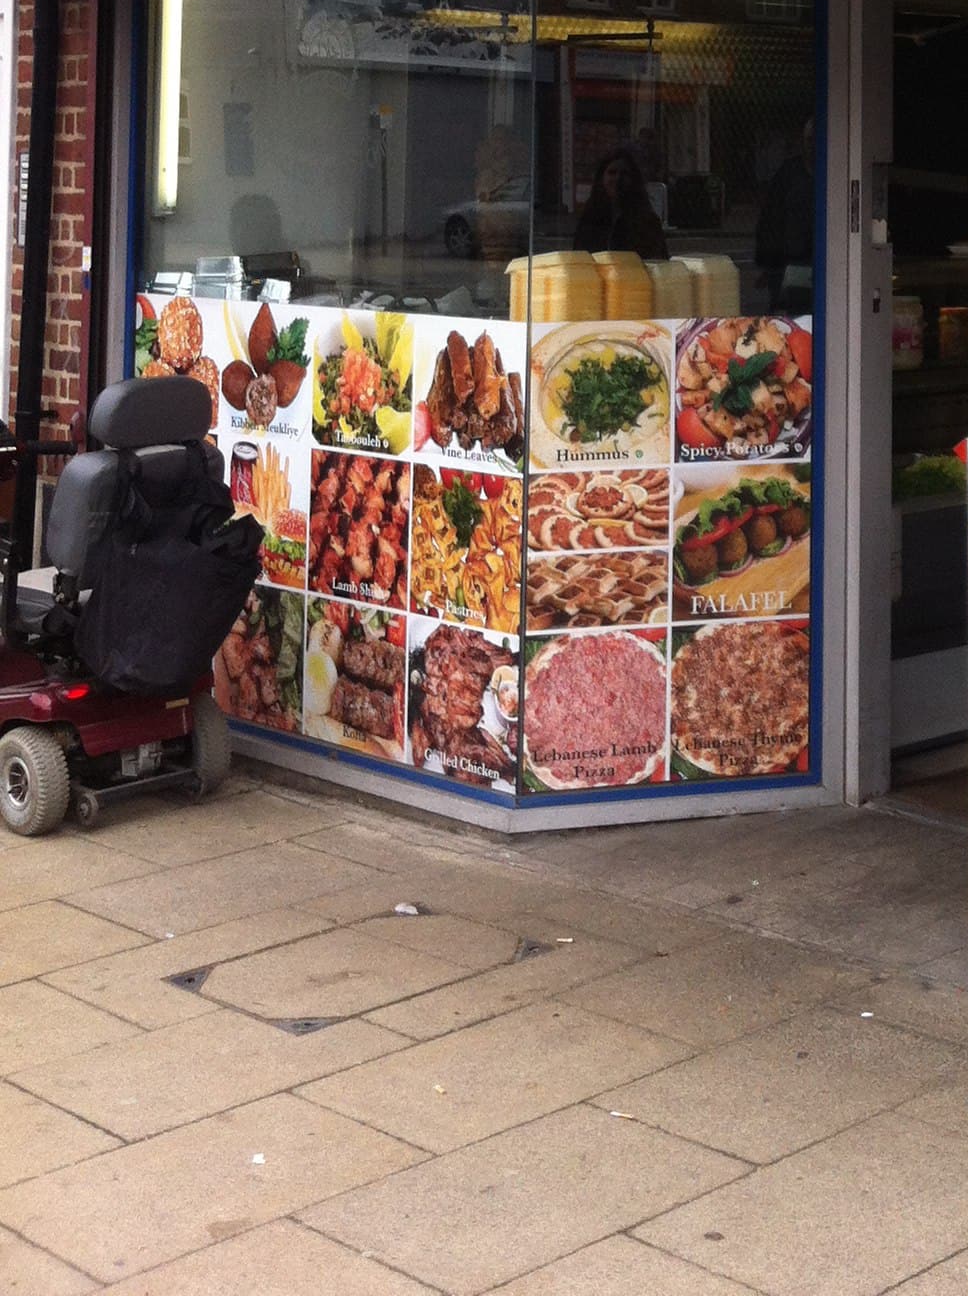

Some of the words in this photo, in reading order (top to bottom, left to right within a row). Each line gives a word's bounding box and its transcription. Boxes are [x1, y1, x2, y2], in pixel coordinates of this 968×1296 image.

[464, 449, 498, 463] Leaves
[556, 448, 630, 462] Hummus
[680, 442, 723, 460] Spicy
[332, 576, 357, 592] Lamb
[690, 590, 793, 616] FALAFEL
[531, 747, 607, 763] Lebanese
[611, 742, 657, 757] Lamb
[459, 754, 500, 780] Chicken
[573, 765, 616, 779] Pizza
